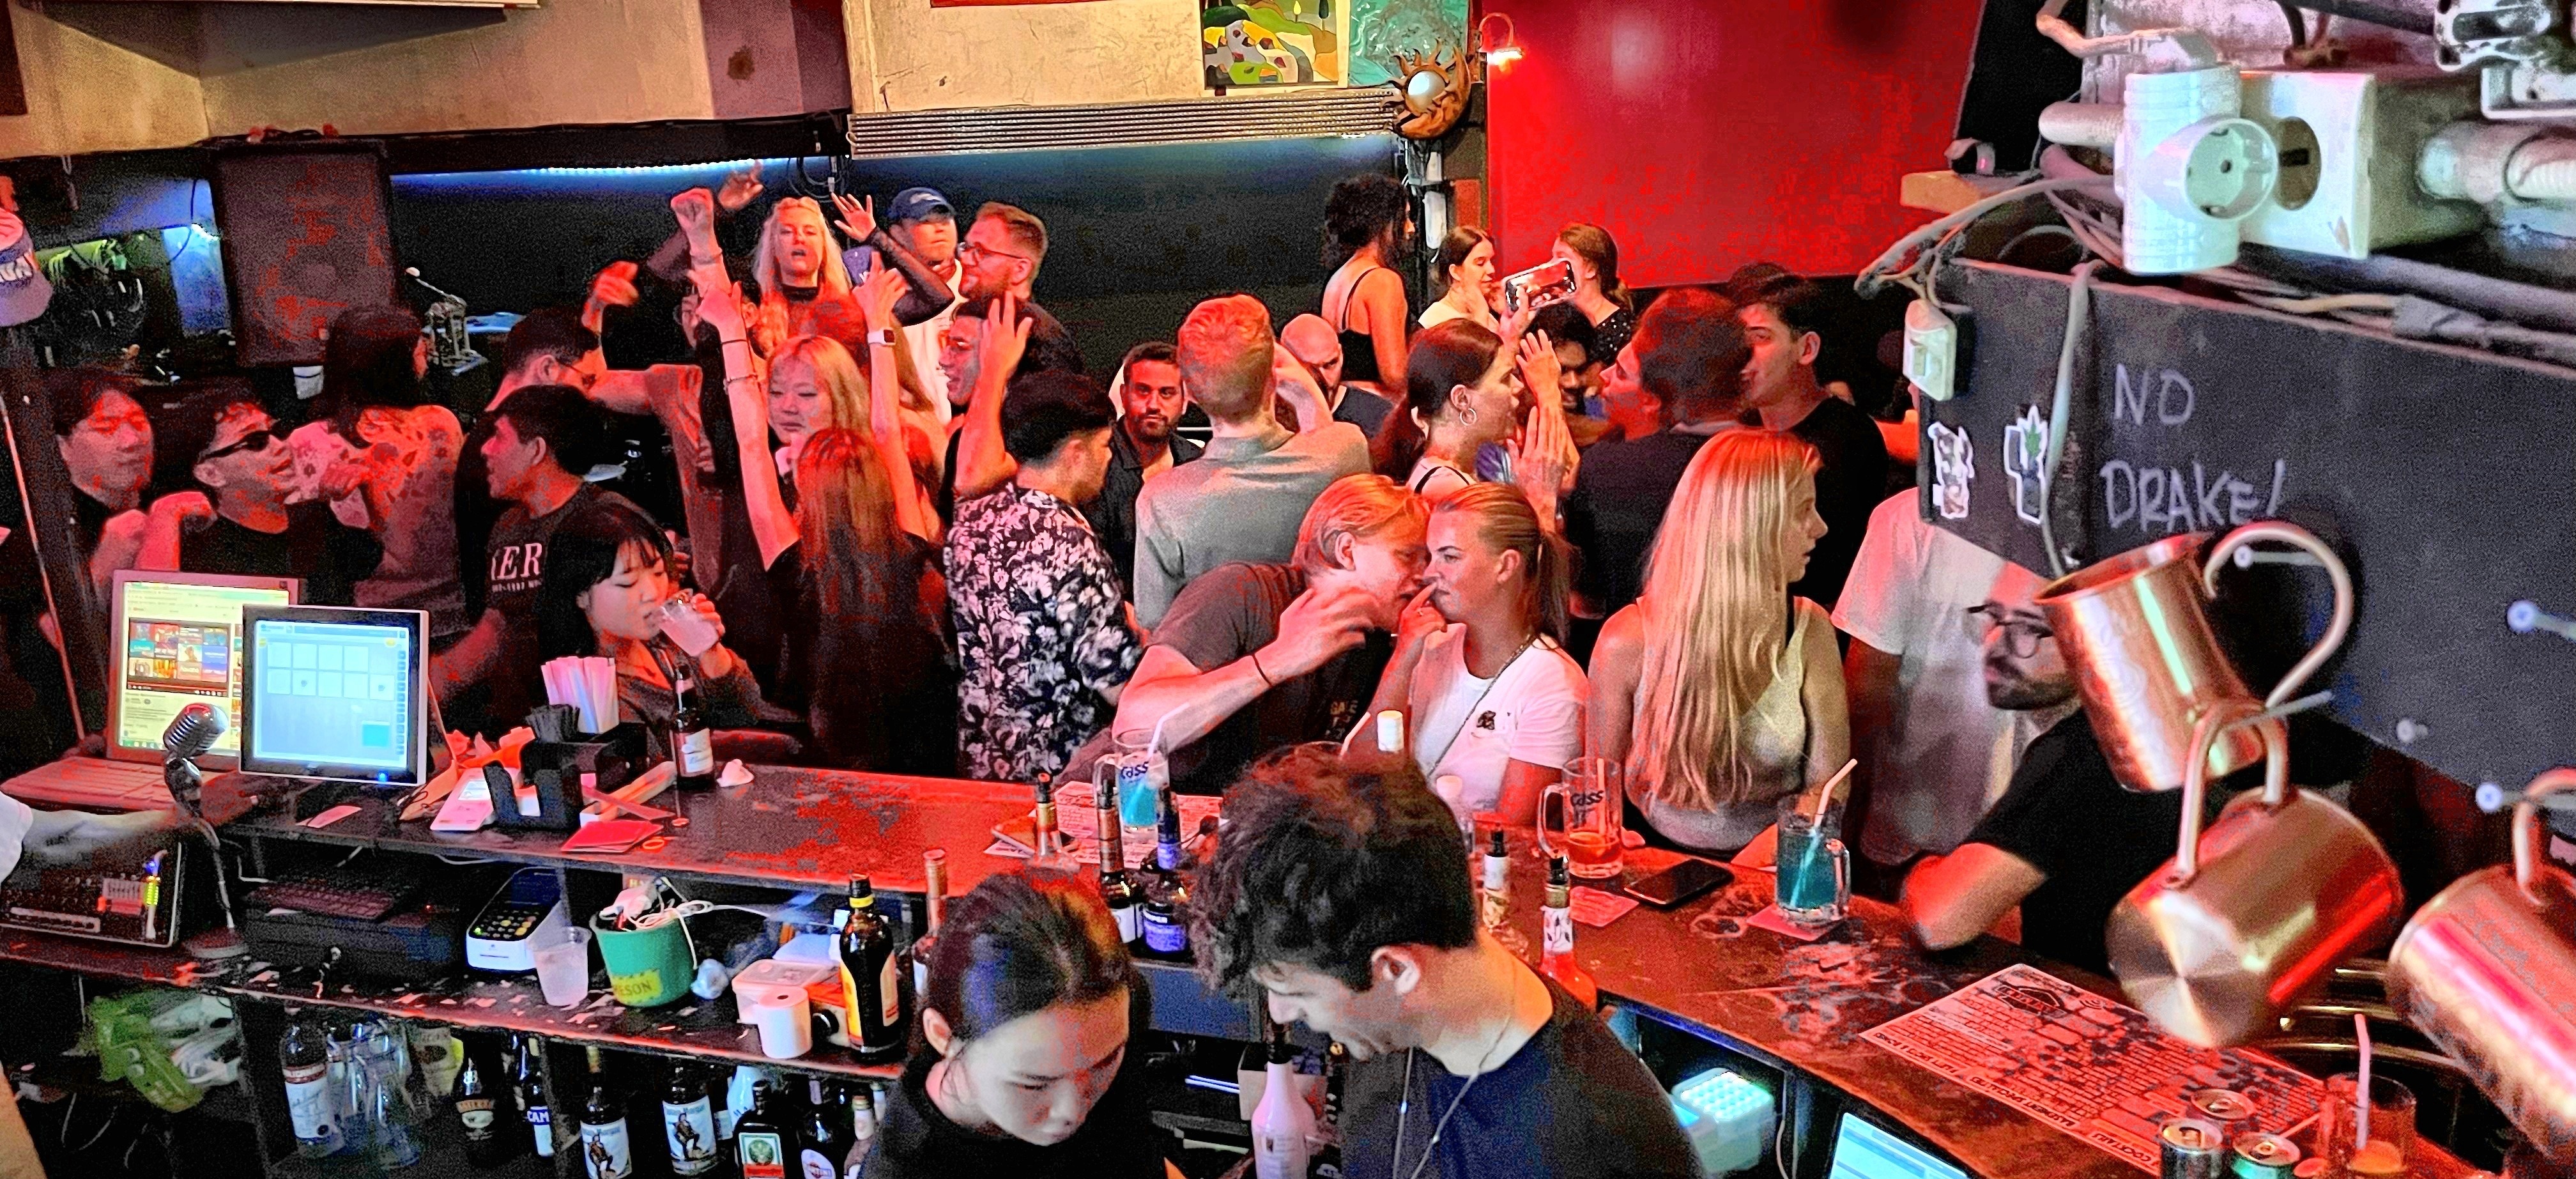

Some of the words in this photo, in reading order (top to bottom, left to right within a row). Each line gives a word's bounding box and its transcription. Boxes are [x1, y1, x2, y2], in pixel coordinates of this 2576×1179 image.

[2114, 364, 2194, 426] NO
[2099, 459, 2285, 532] DRAKE!
[2092, 1133, 2152, 1162] COCKTAILS
